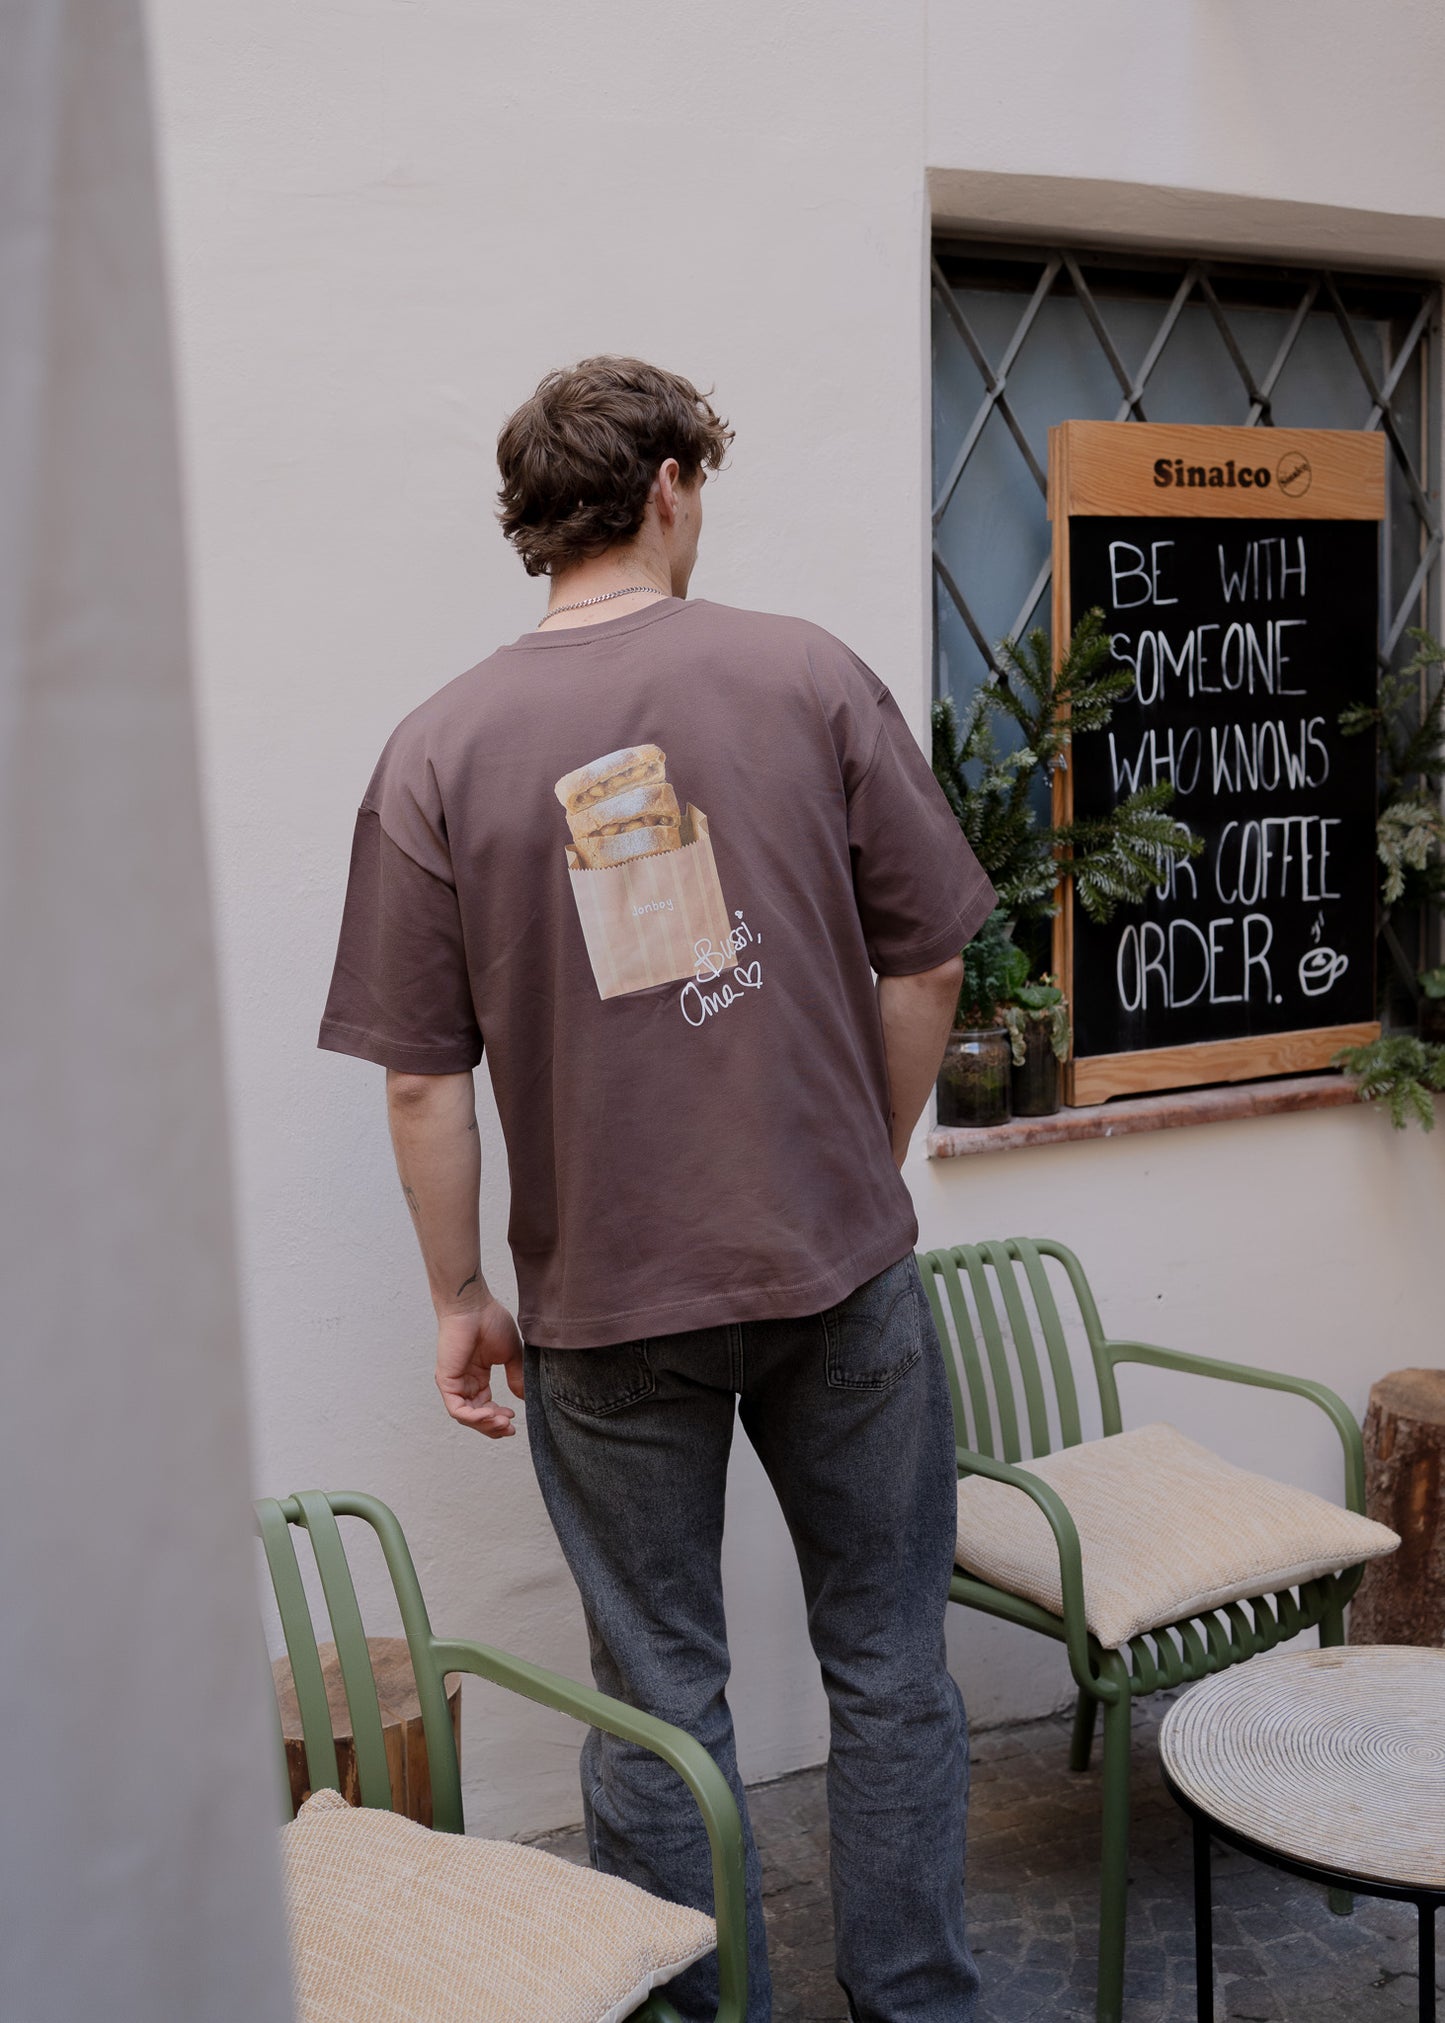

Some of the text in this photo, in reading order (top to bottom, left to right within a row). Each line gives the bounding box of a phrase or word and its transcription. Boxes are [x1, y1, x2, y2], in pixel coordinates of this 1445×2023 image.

[1153, 458, 1271, 488] Sinalco
[1109, 536, 1306, 608] BE WITH
[1110, 620, 1307, 705] SOMEONE
[1109, 717, 1329, 795] WHO KNOWS
[1216, 816, 1342, 904] COFFEE
[1117, 914, 1283, 1011] ORDER.
[680, 982, 745, 1026] Oma
